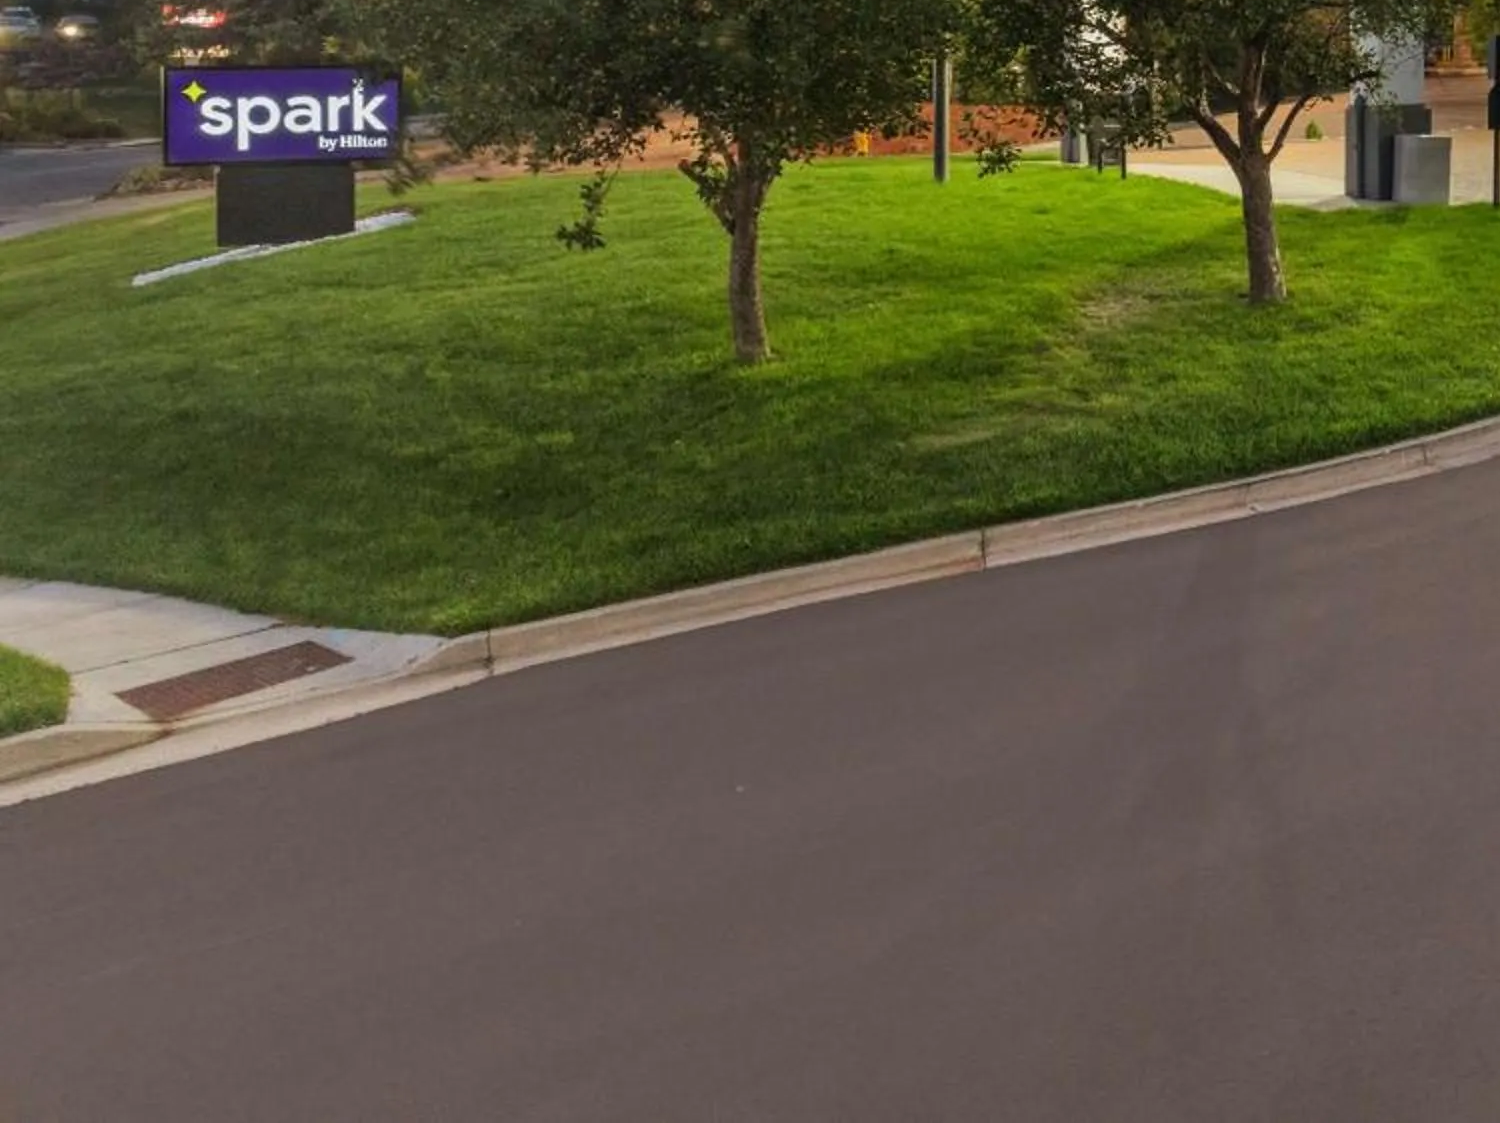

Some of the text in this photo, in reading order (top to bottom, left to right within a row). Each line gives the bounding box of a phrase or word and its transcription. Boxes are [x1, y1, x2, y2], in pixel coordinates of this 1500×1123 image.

[200, 79, 388, 151] spark
[318, 135, 388, 151] by Hilton
